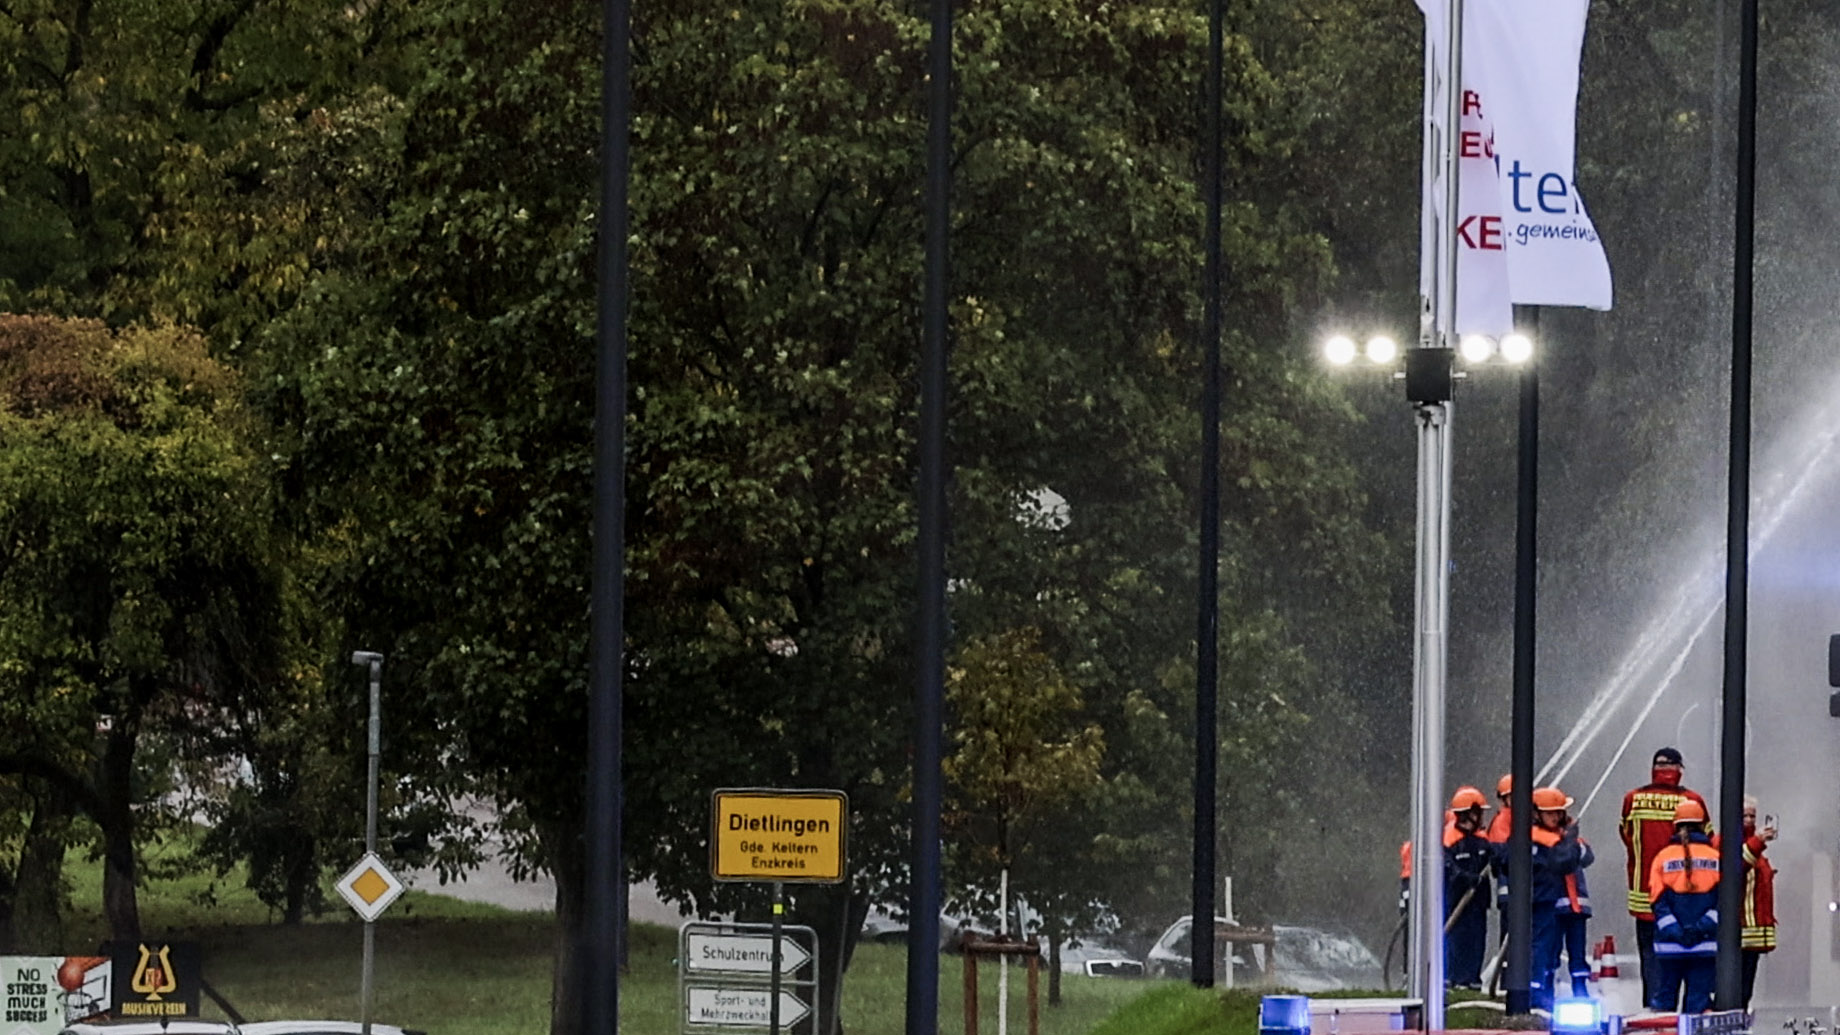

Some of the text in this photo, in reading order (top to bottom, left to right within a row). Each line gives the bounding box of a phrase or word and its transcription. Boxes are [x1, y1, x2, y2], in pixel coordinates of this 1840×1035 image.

[729, 814, 830, 836] Dietlingen
[772, 842, 818, 854] Keltern
[751, 856, 806, 869] Enzkreis
[18, 968, 40, 982] NO
[7, 983, 47, 995] STRESS
[8, 996, 46, 1009] MUCH
[6, 1010, 47, 1022] SUCCESS
[701, 1008, 769, 1020] Mehrzweckhal
